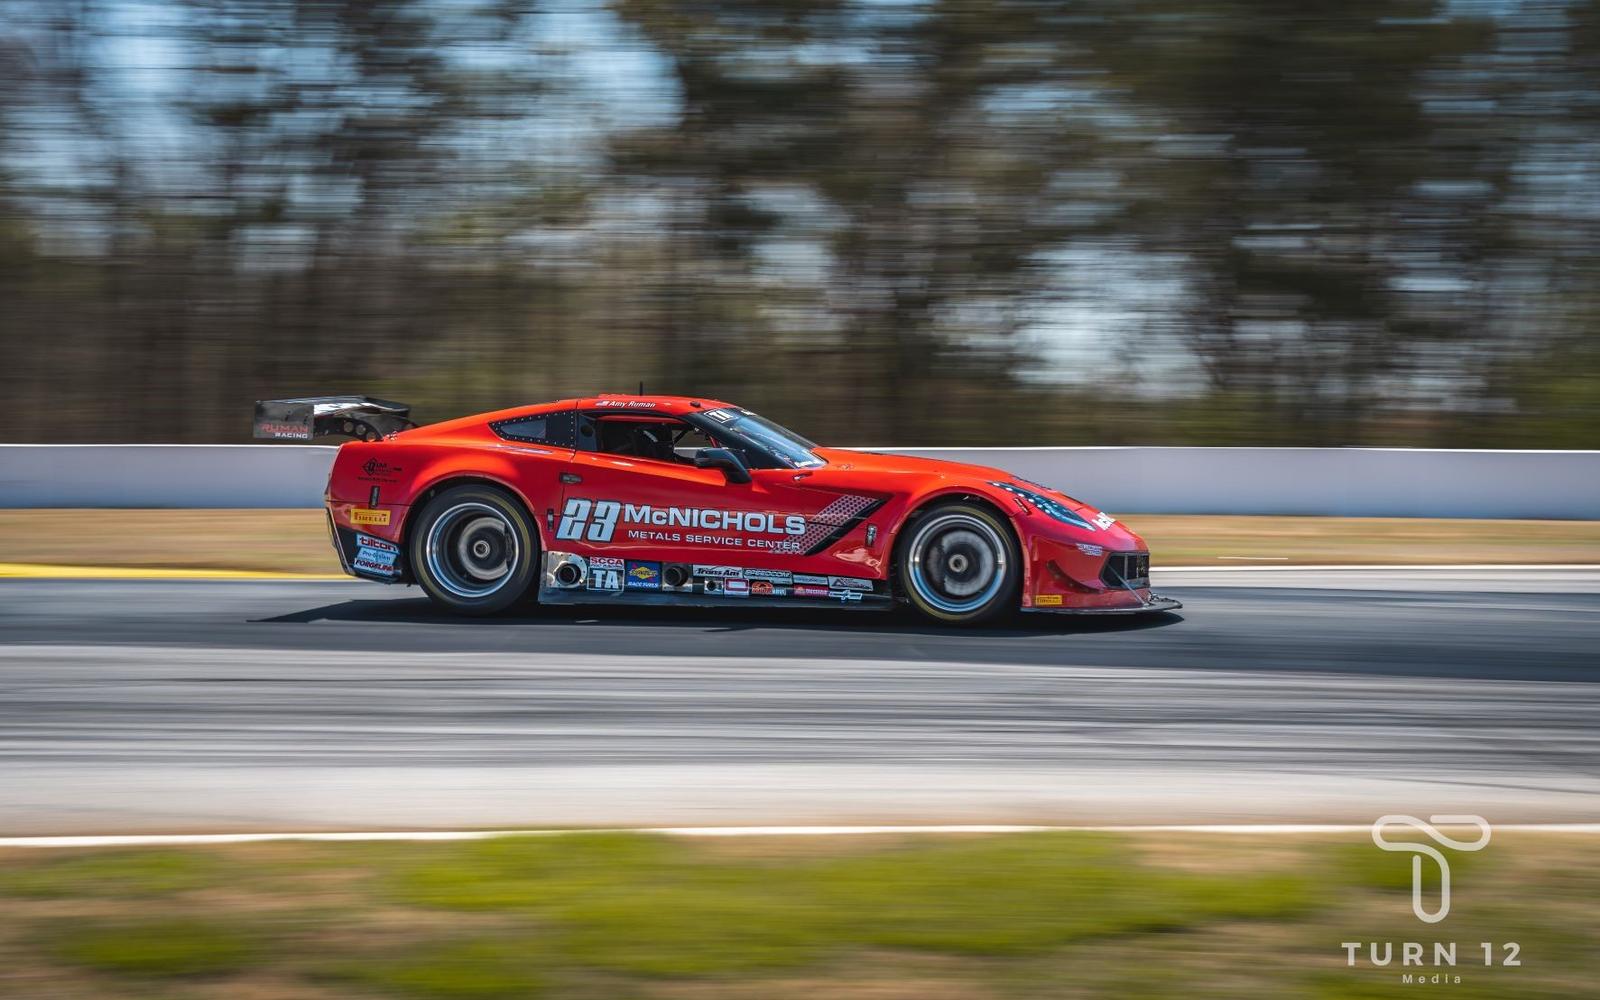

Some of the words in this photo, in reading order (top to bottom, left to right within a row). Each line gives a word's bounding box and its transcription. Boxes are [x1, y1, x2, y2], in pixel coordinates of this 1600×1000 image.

[261, 423, 308, 433] RUMAN
[354, 512, 387, 523] PIRELLI
[556, 499, 622, 543] 23
[625, 503, 806, 535] McNICHOLS
[628, 529, 681, 542] METALS
[686, 534, 742, 546] SERVICE
[747, 539, 801, 550] CENTER
[590, 557, 623, 565] SCCA
[696, 567, 722, 575] Trans
[592, 569, 619, 589] TA
